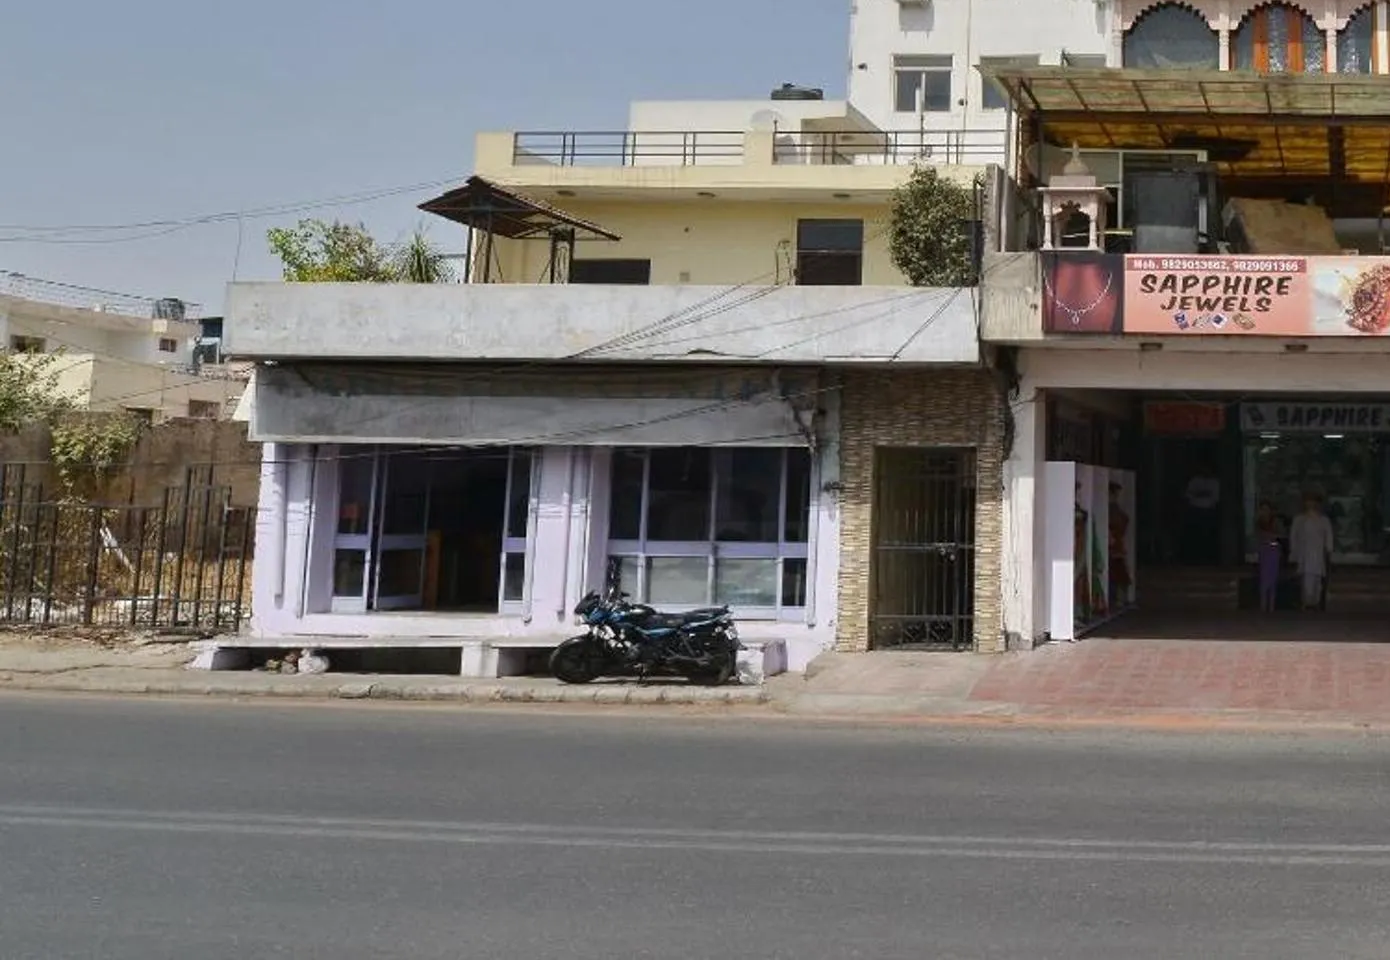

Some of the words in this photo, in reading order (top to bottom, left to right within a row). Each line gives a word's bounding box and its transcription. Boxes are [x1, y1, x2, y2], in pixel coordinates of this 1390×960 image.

[1139, 272, 1293, 295] SAPPHIRE
[1159, 295, 1273, 313] JEWELS
[1276, 406, 1382, 427] SAPPHIRE
